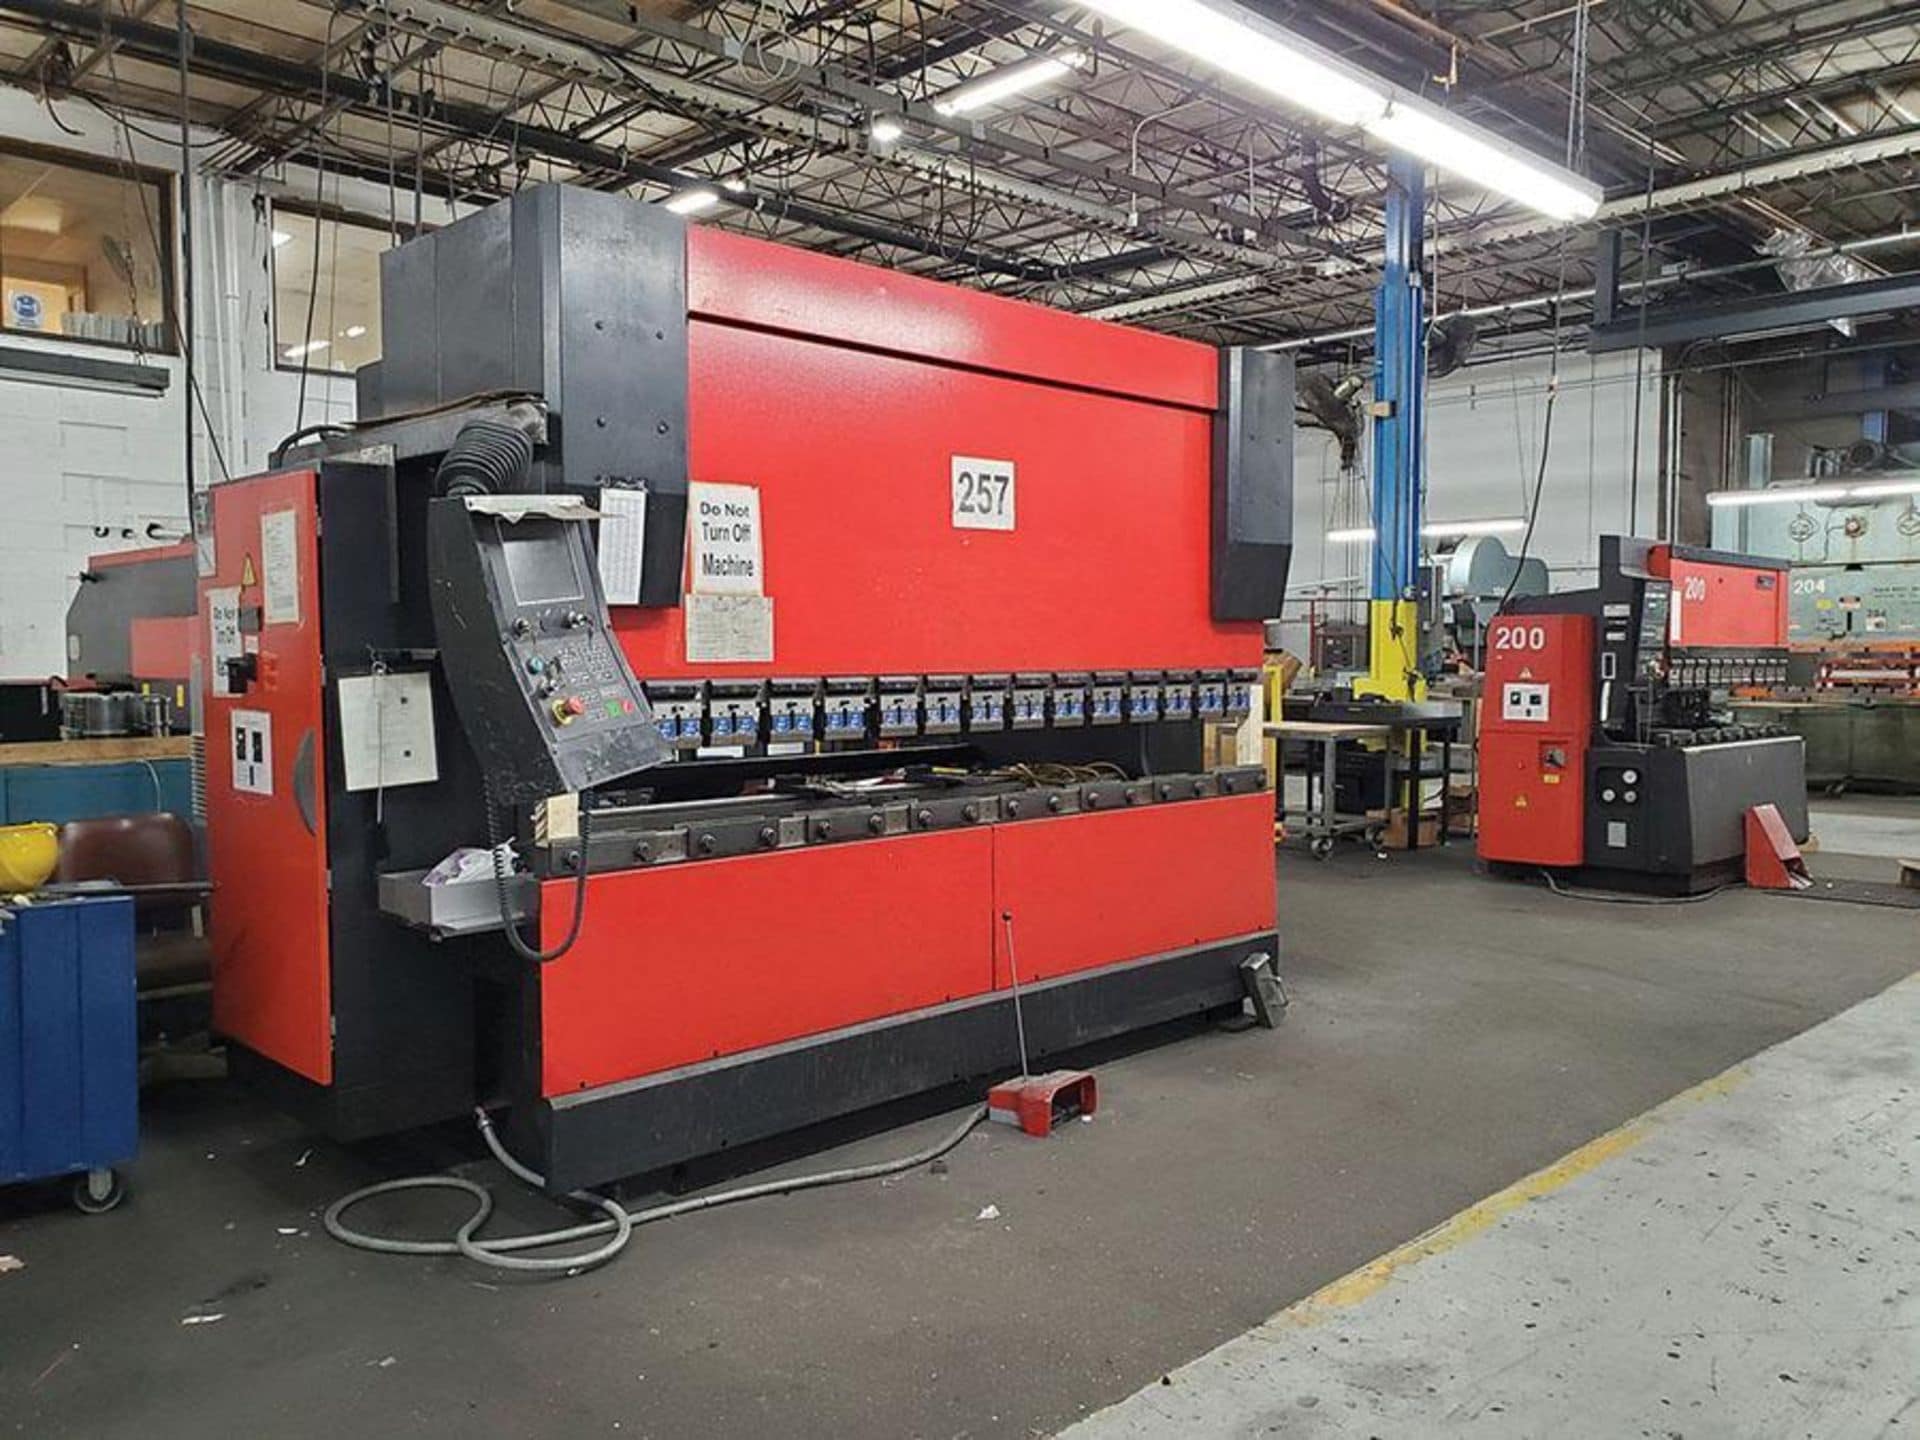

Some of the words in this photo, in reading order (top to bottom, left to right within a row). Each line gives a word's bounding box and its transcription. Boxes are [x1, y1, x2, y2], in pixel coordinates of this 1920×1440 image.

[958, 471, 1010, 515] 257
[700, 501, 721, 516] Do
[725, 504, 750, 518] Not
[702, 522, 730, 541] Turn
[732, 523, 752, 542] Off
[702, 553, 754, 577] Machine
[1684, 576, 1706, 601] 200
[1793, 578, 1825, 594] 204
[1495, 626, 1545, 650] 200
